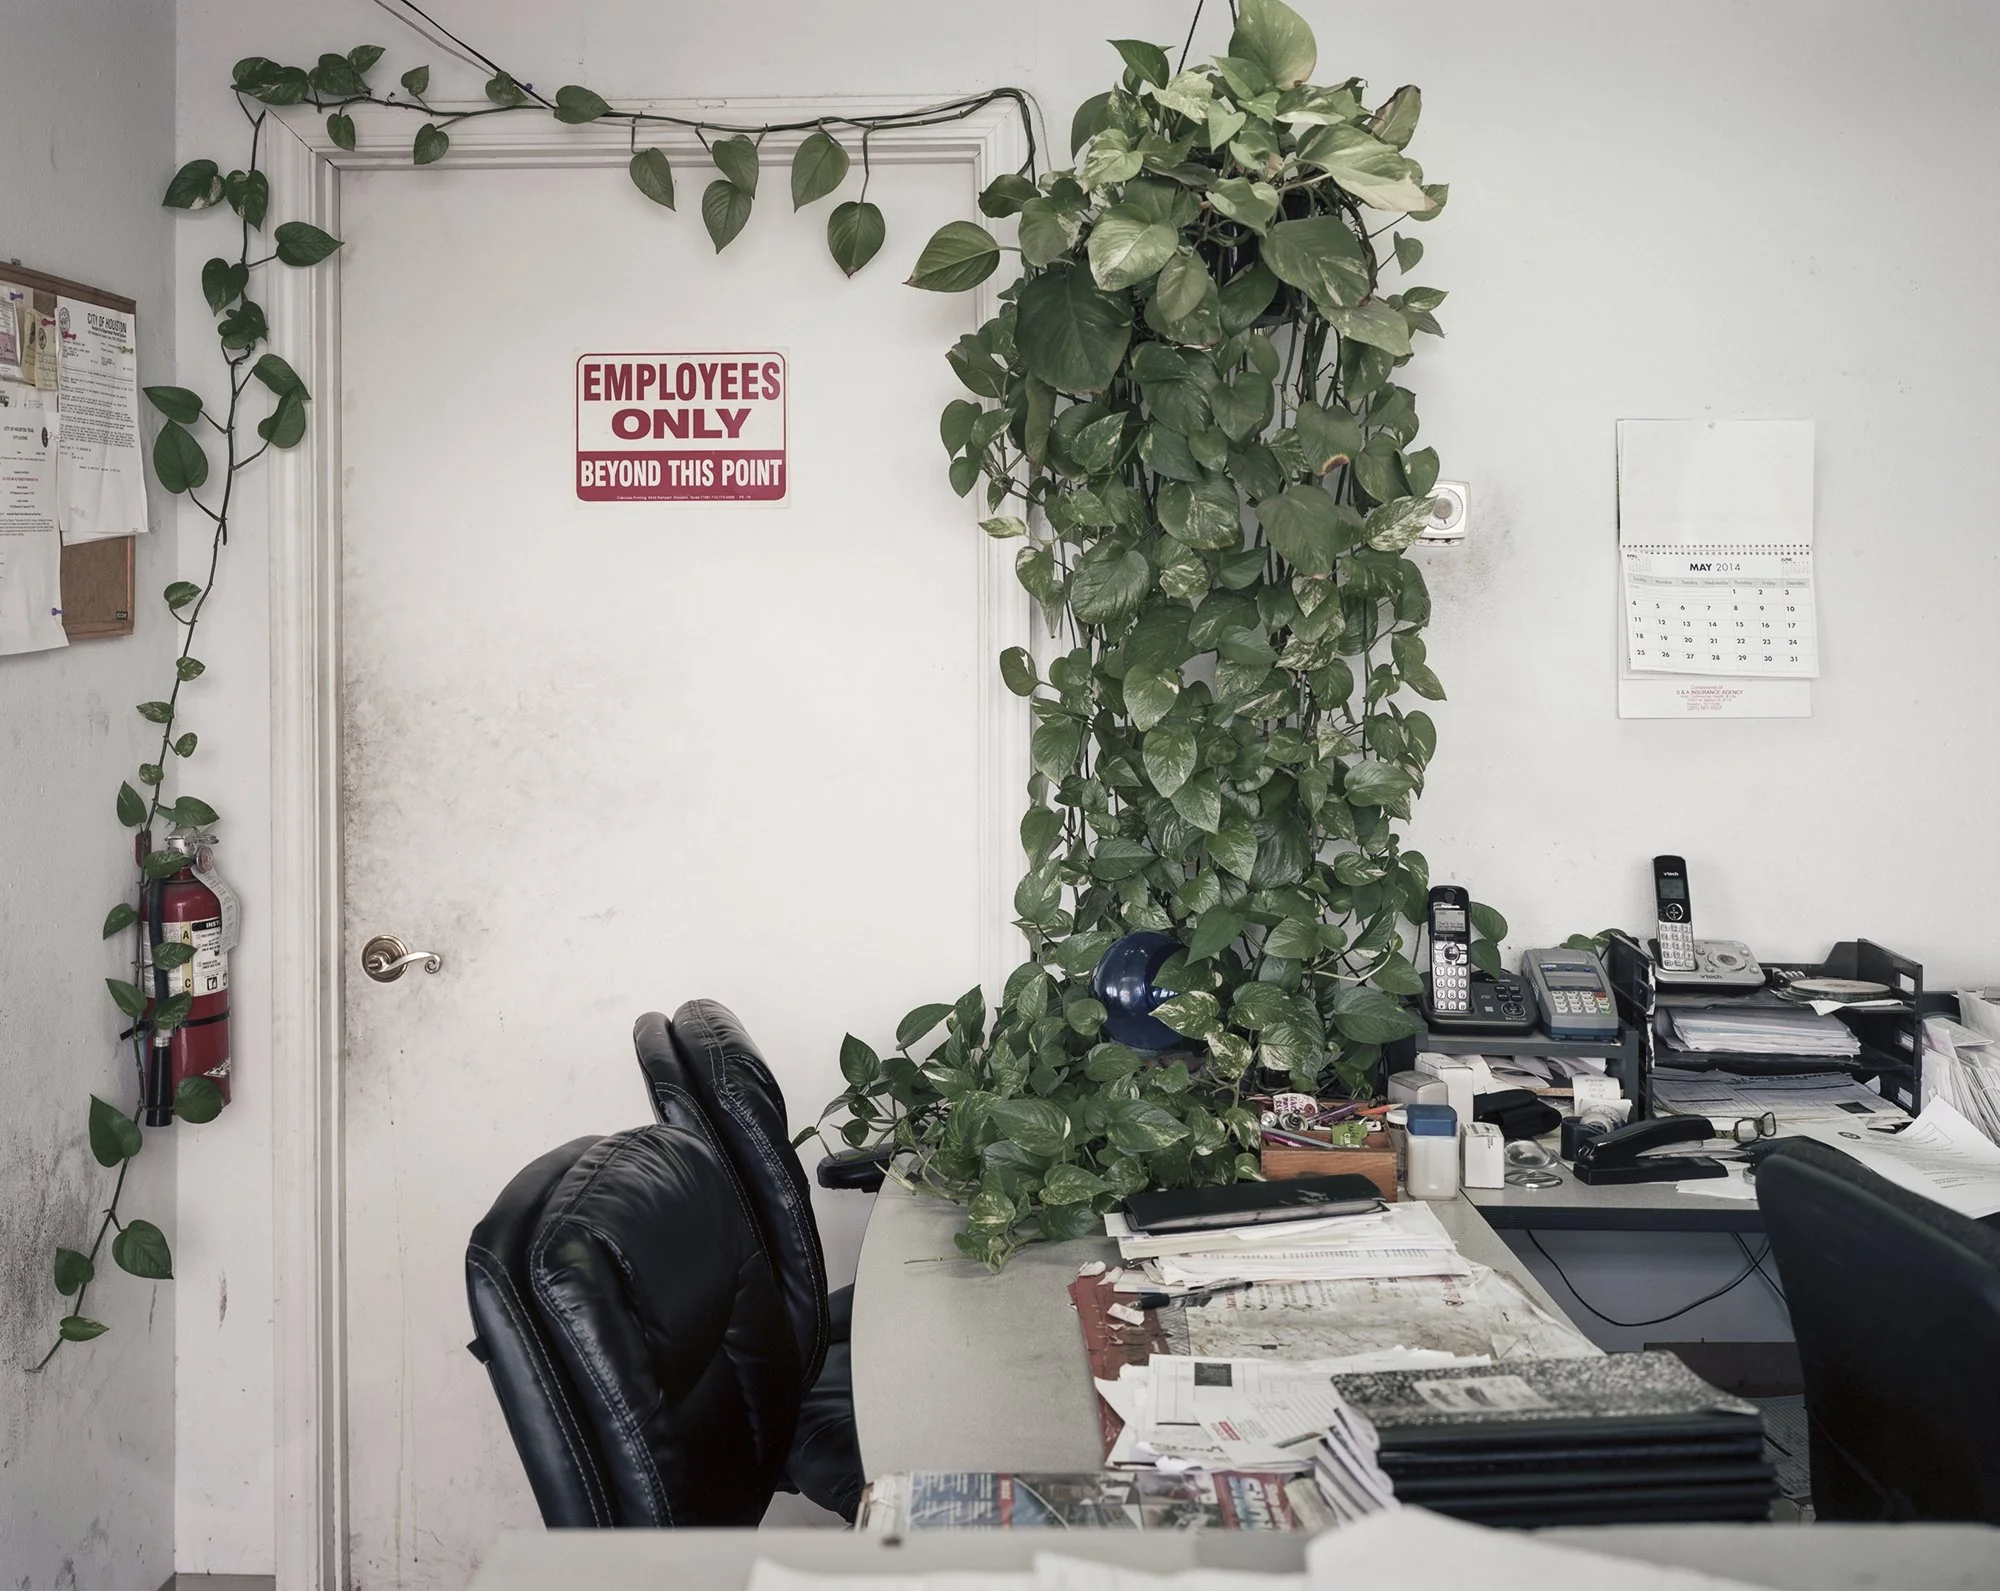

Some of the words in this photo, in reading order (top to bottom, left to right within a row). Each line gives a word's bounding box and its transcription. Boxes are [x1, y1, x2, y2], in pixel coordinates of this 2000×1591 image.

[88, 312, 98, 326] CITY
[100, 316, 104, 327] OF
[105, 318, 126, 334] HOUSTON
[583, 361, 781, 402] EMPLOYEES
[611, 408, 752, 440] ONLY
[580, 460, 661, 488] BEYOND
[668, 459, 714, 488] THIS
[721, 458, 782, 487] POINT
[1690, 563, 1712, 571] MAY
[1716, 562, 1741, 572] 2014
[182, 930, 189, 939] A
[184, 978, 191, 988] C
